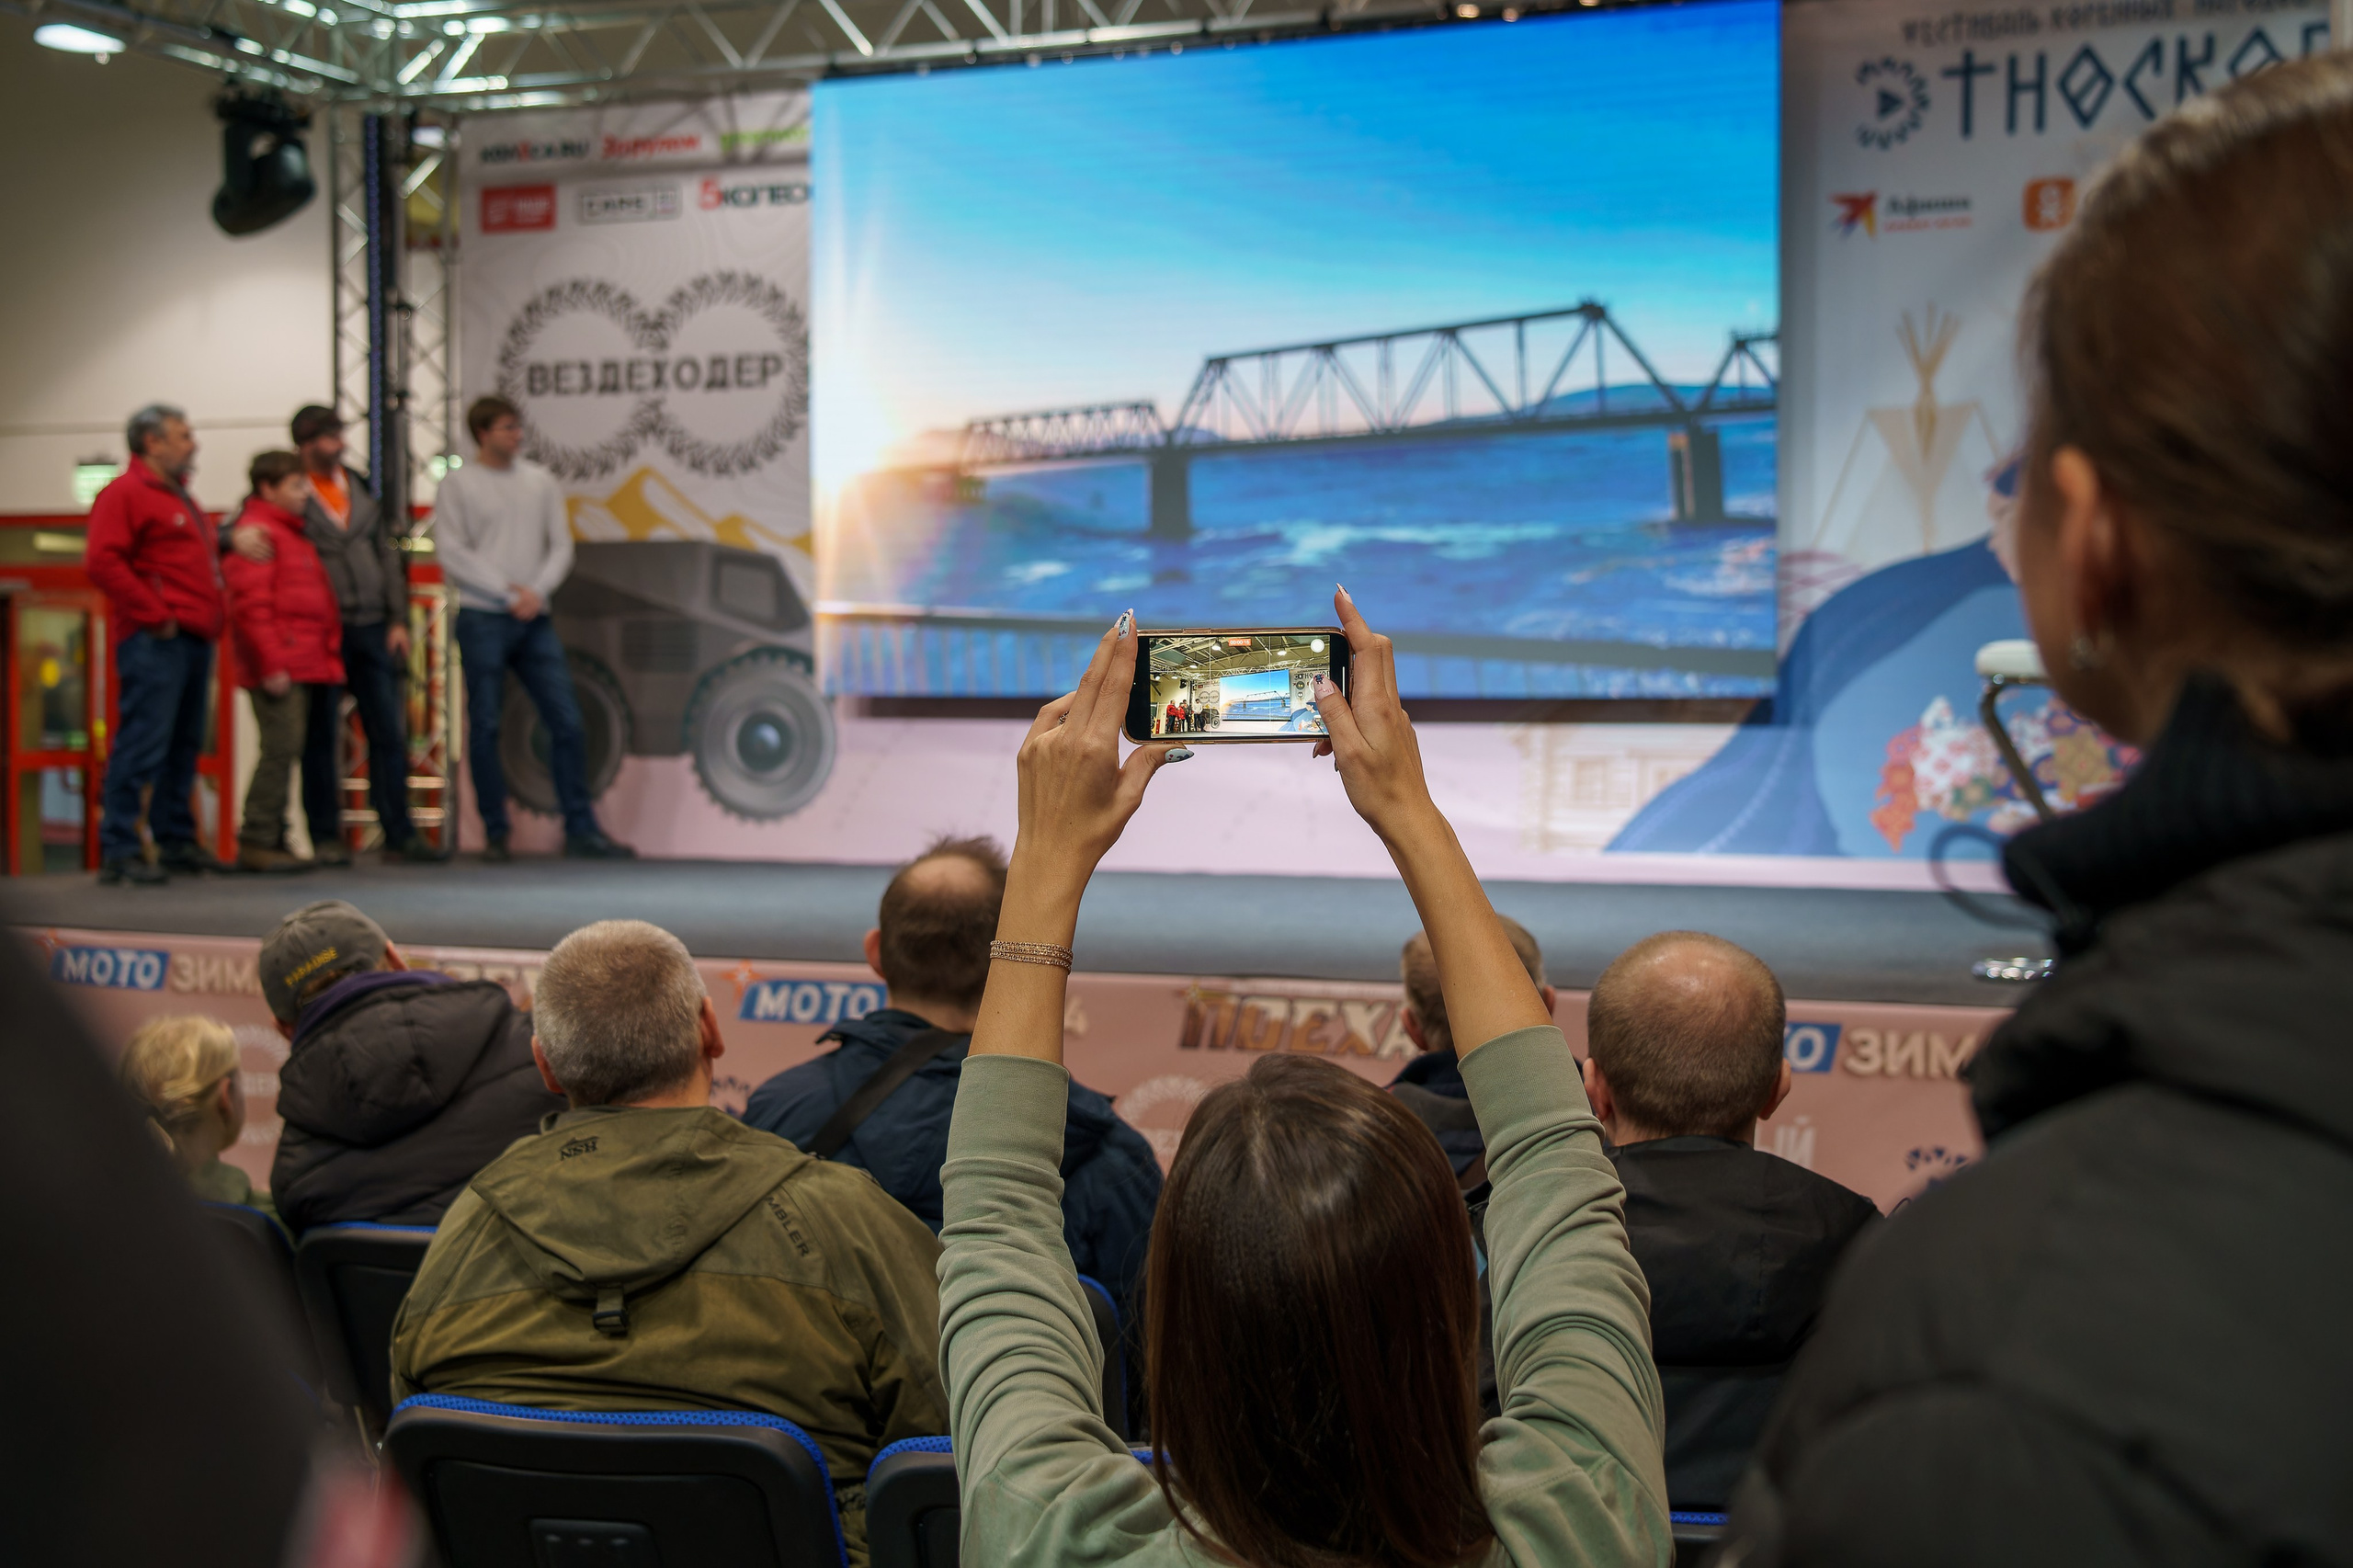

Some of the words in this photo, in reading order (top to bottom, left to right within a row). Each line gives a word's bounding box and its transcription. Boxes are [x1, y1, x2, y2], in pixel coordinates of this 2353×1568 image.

[526, 353, 783, 397] ВЕЗДЕХОДЕР
[62, 949, 162, 990] МОТО
[171, 951, 261, 994] ЗИМ
[754, 982, 880, 1022] МОТО
[1180, 993, 1425, 1059] ПОЕХА
[1845, 1028, 1975, 1079] ЗИМ
[765, 1196, 810, 1258] MBLER
